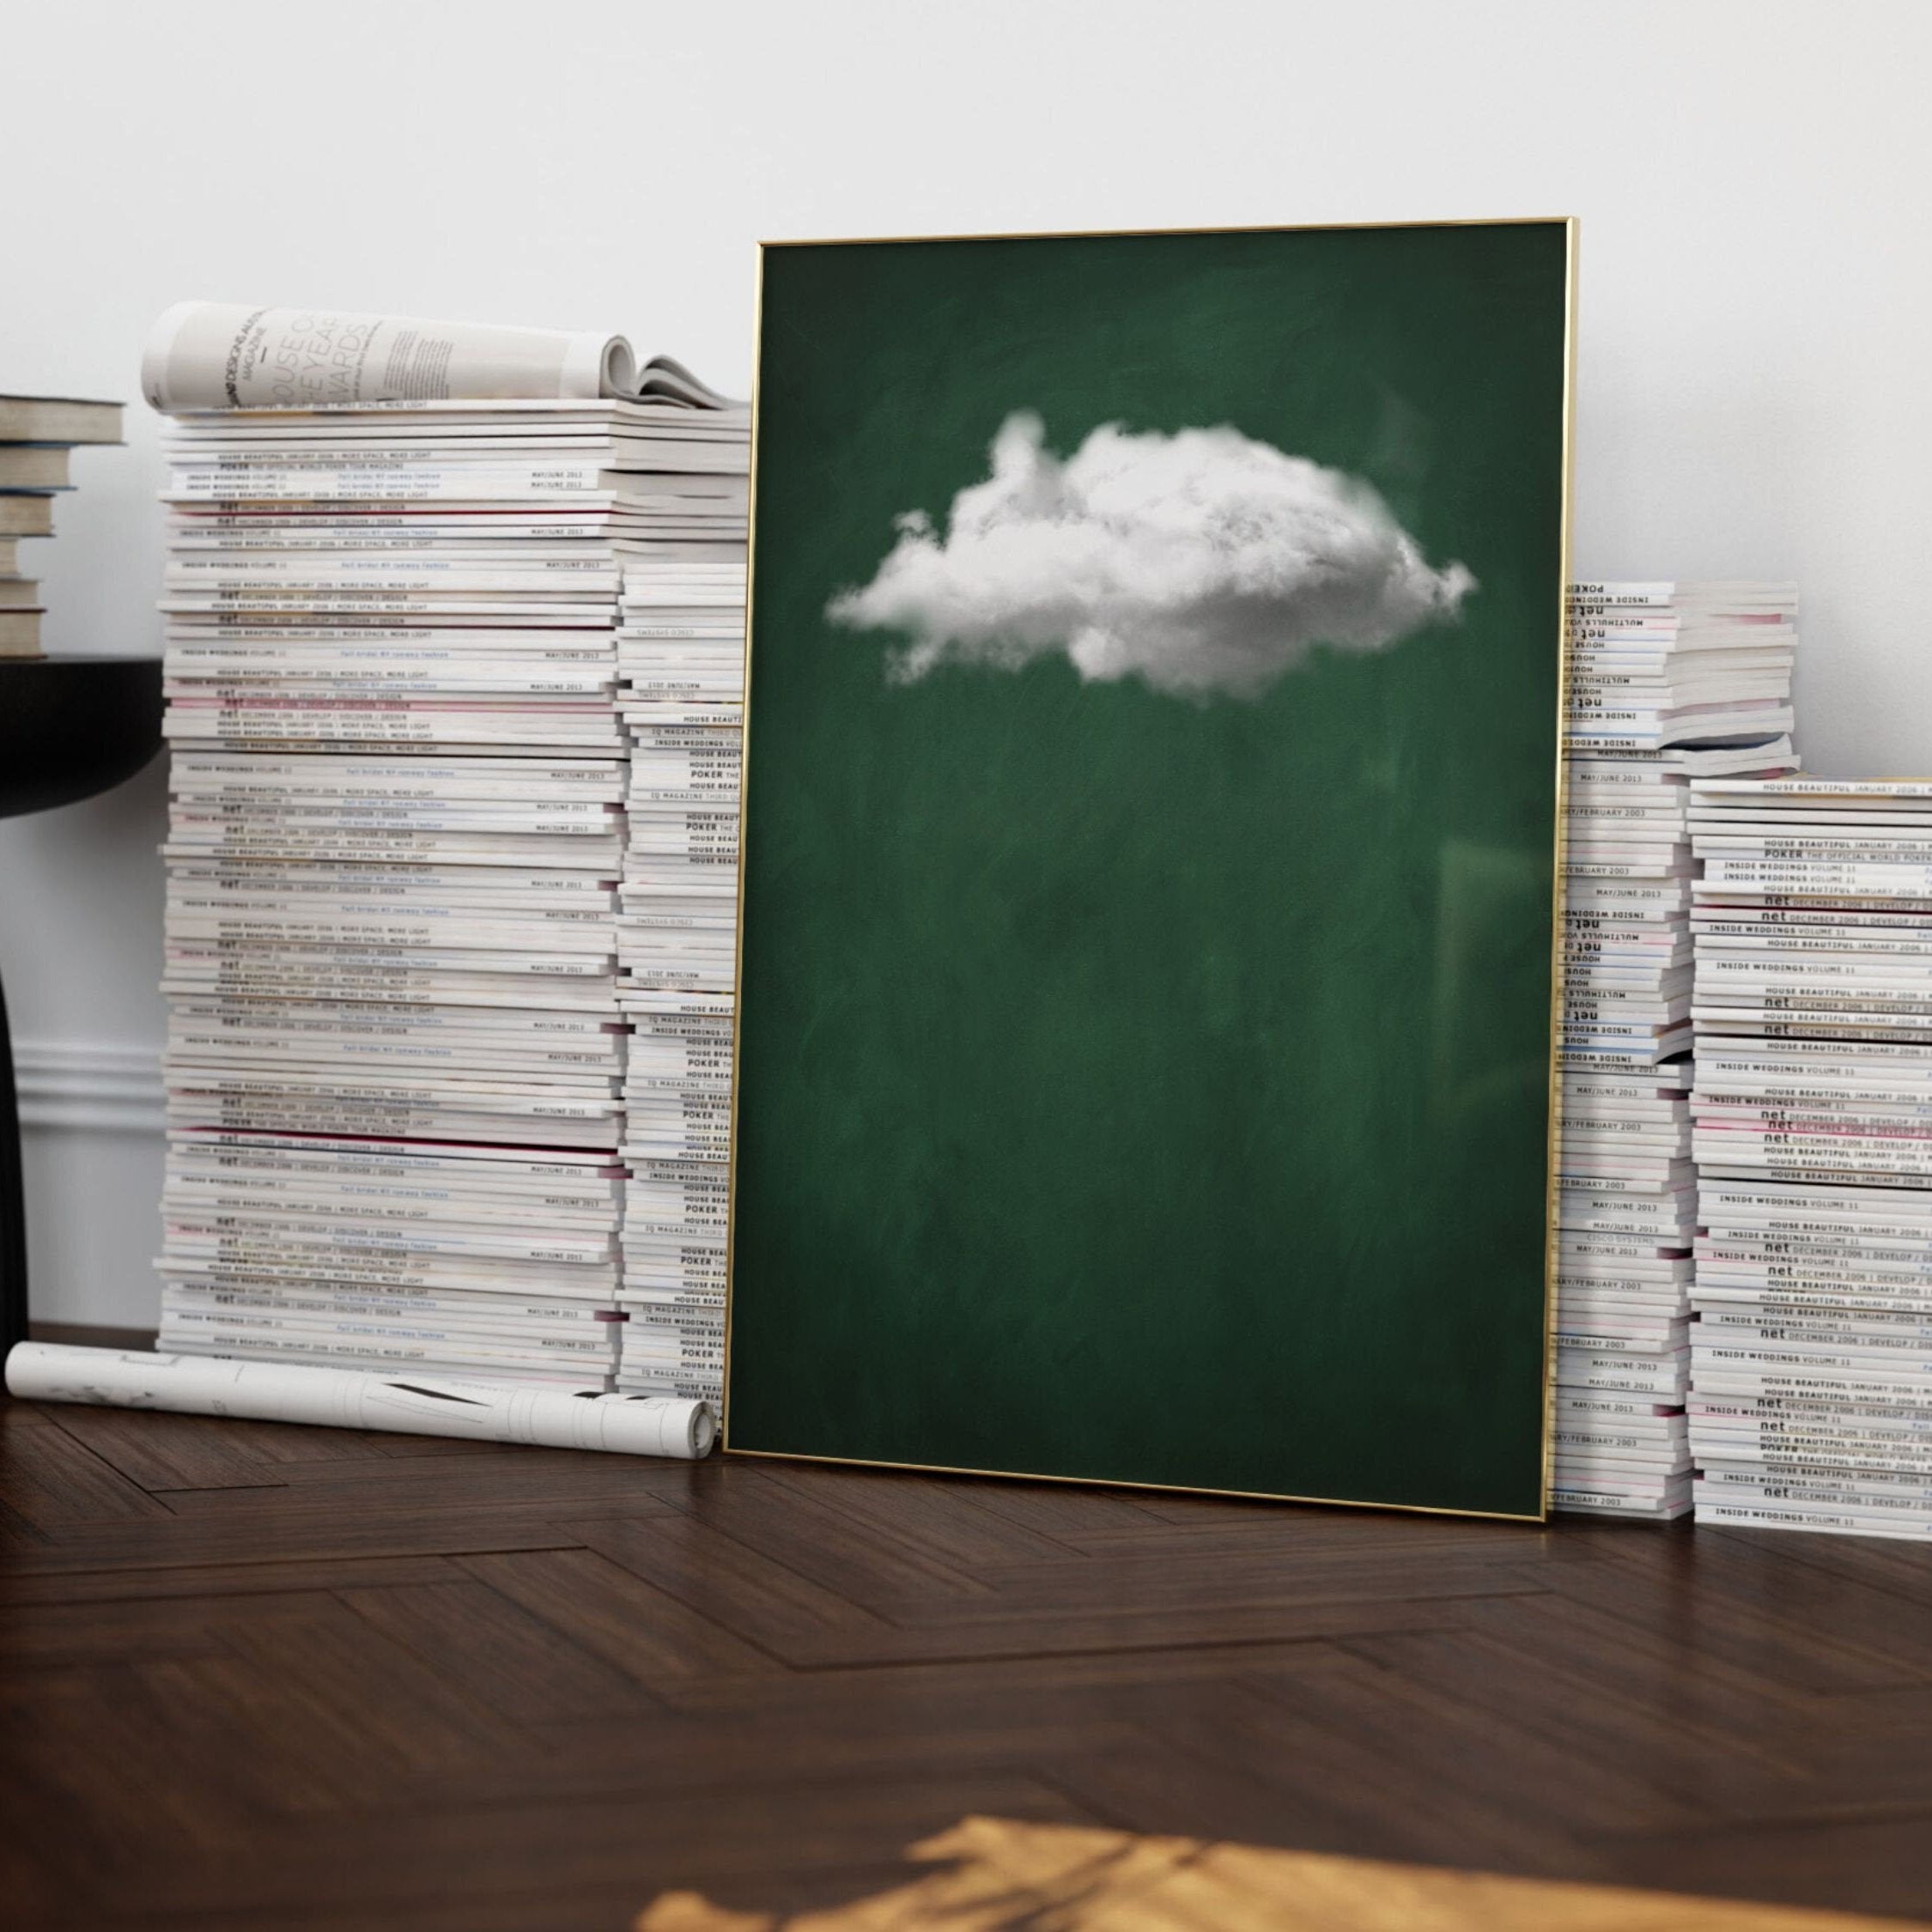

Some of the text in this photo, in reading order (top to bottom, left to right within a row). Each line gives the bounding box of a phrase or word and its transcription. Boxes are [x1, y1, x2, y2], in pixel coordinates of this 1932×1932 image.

[1798, 783, 1850, 792] BEAUTIFUL
[686, 823, 717, 831] POKER
[1765, 848, 1802, 858] POKER
[1759, 862, 1807, 871] WEDDINGS
[1761, 910, 1786, 921] net
[1745, 925, 1795, 934] WEDDINGS
[1753, 963, 1804, 972] WEDDINGS
[1800, 987, 1852, 997] BEAUTIFUL
[1577, 1087, 1637, 1097] MAY/JUNE 2013
[1765, 1087, 1796, 1096] HOUSE
[1800, 1089, 1852, 1098] BEAUTIFUL
[1764, 1131, 1789, 1143] net
[1764, 1145, 1795, 1154] HOUSE
[1798, 1147, 1850, 1157] BEAUTIFUL
[1720, 1194, 1753, 1203] INSIDE
[1756, 1196, 1807, 1206] WEDDINGS
[1593, 1202, 1633, 1211] MAY/JUNE
[681, 1257, 712, 1266] POKER
[674, 1318, 714, 1327] WEDDINGS
[1712, 1349, 1745, 1358] INSIDE
[1748, 1352, 1800, 1363] WEDDINGS
[1592, 1360, 1633, 1369] MAY/JUNE
[1760, 1434, 1791, 1443] HOUSE
[1795, 1437, 1847, 1448] BEAUTIFUL
[1716, 1507, 1748, 1517] INSIDE
[1752, 1510, 1803, 1522] WEDDINGS
